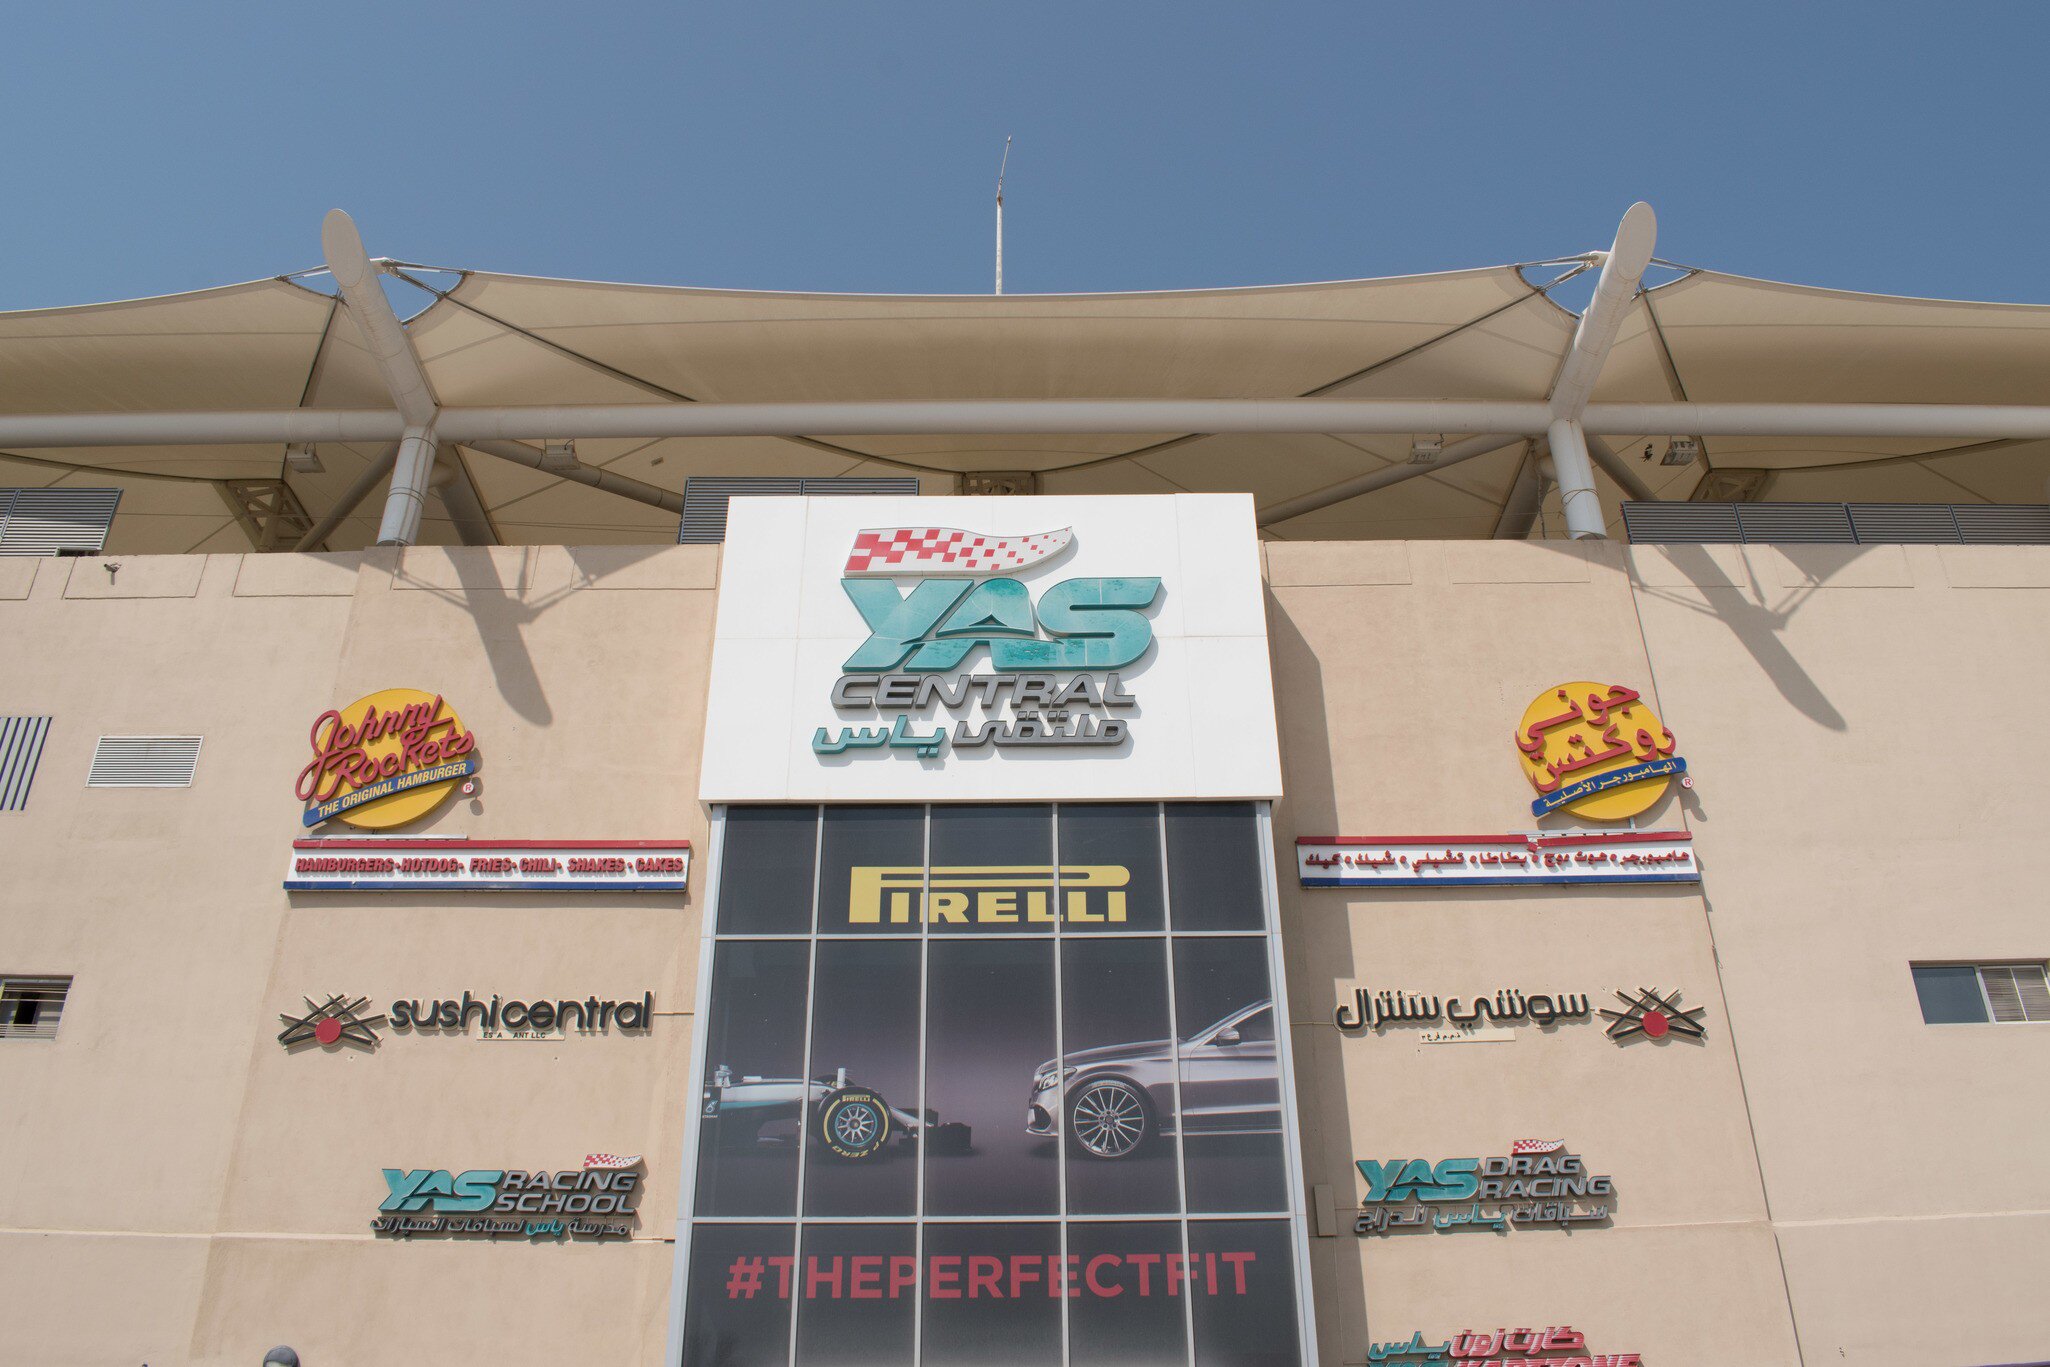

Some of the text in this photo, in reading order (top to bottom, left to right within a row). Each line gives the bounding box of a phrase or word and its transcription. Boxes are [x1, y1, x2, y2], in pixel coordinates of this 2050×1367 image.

[840, 576, 1162, 673] YAS
[830, 673, 1136, 709] CENTRAL
[811, 714, 947, 759] ياس
[1514, 685, 1640, 762] جوني
[295, 694, 454, 801] Johnny
[311, 725, 475, 802] Rockets
[1532, 723, 1676, 792] روكتس
[318, 762, 468, 818] THE ORIGINAL HAMBURGER
[1544, 780, 1597, 808] الأصلية
[296, 858, 683, 872] HAMBURGERS HOTDOG FRIES CHILI SHAKES CAKES
[849, 865, 1131, 923] PIRELLI
[389, 990, 651, 1028] sushicentral
[1337, 988, 1589, 1029] سوشي سنترال
[378, 1168, 639, 1212] YAS RACING
[1355, 1154, 1581, 1202] YAS DRAG
[1479, 1175, 1612, 1199] RACING
[494, 1193, 636, 1213] SCHOOL
[1433, 1203, 1506, 1231] ياس
[525, 1219, 564, 1236] ياس
[568, 1217, 628, 1237] مدرسة
[727, 1251, 1256, 1299] #THEPERFECTFIT
[1368, 1330, 1450, 1360] ياس
[1502, 1325, 1585, 1355] كارت
